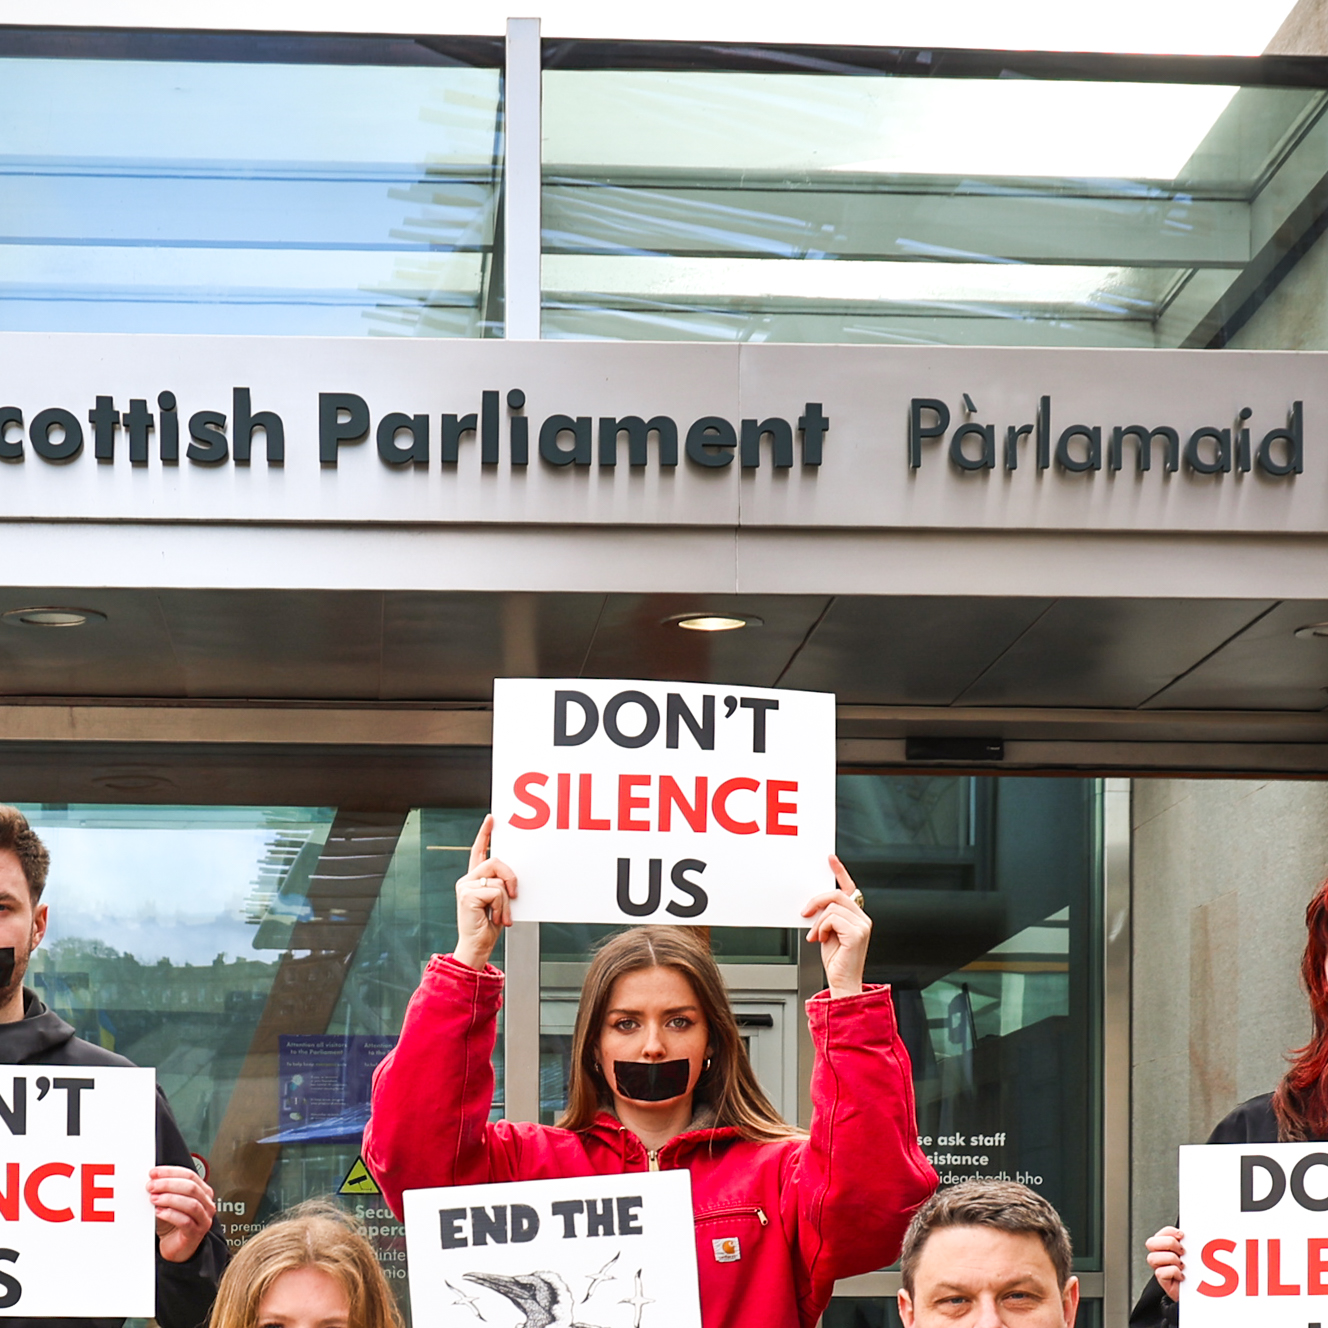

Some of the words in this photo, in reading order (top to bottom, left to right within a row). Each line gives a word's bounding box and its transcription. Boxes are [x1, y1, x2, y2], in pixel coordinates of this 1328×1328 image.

[319, 389, 826, 469] Parliament
[908, 393, 1303, 477] Pàrlamaid
[553, 689, 779, 753] DON'T
[508, 772, 799, 836] SILENCE
[616, 857, 709, 918] US
[925, 1151, 989, 1167] sistance
[937, 1131, 966, 1147] ask
[970, 1131, 1006, 1147] staff
[438, 1204, 540, 1250] END
[551, 1195, 643, 1239] THE
